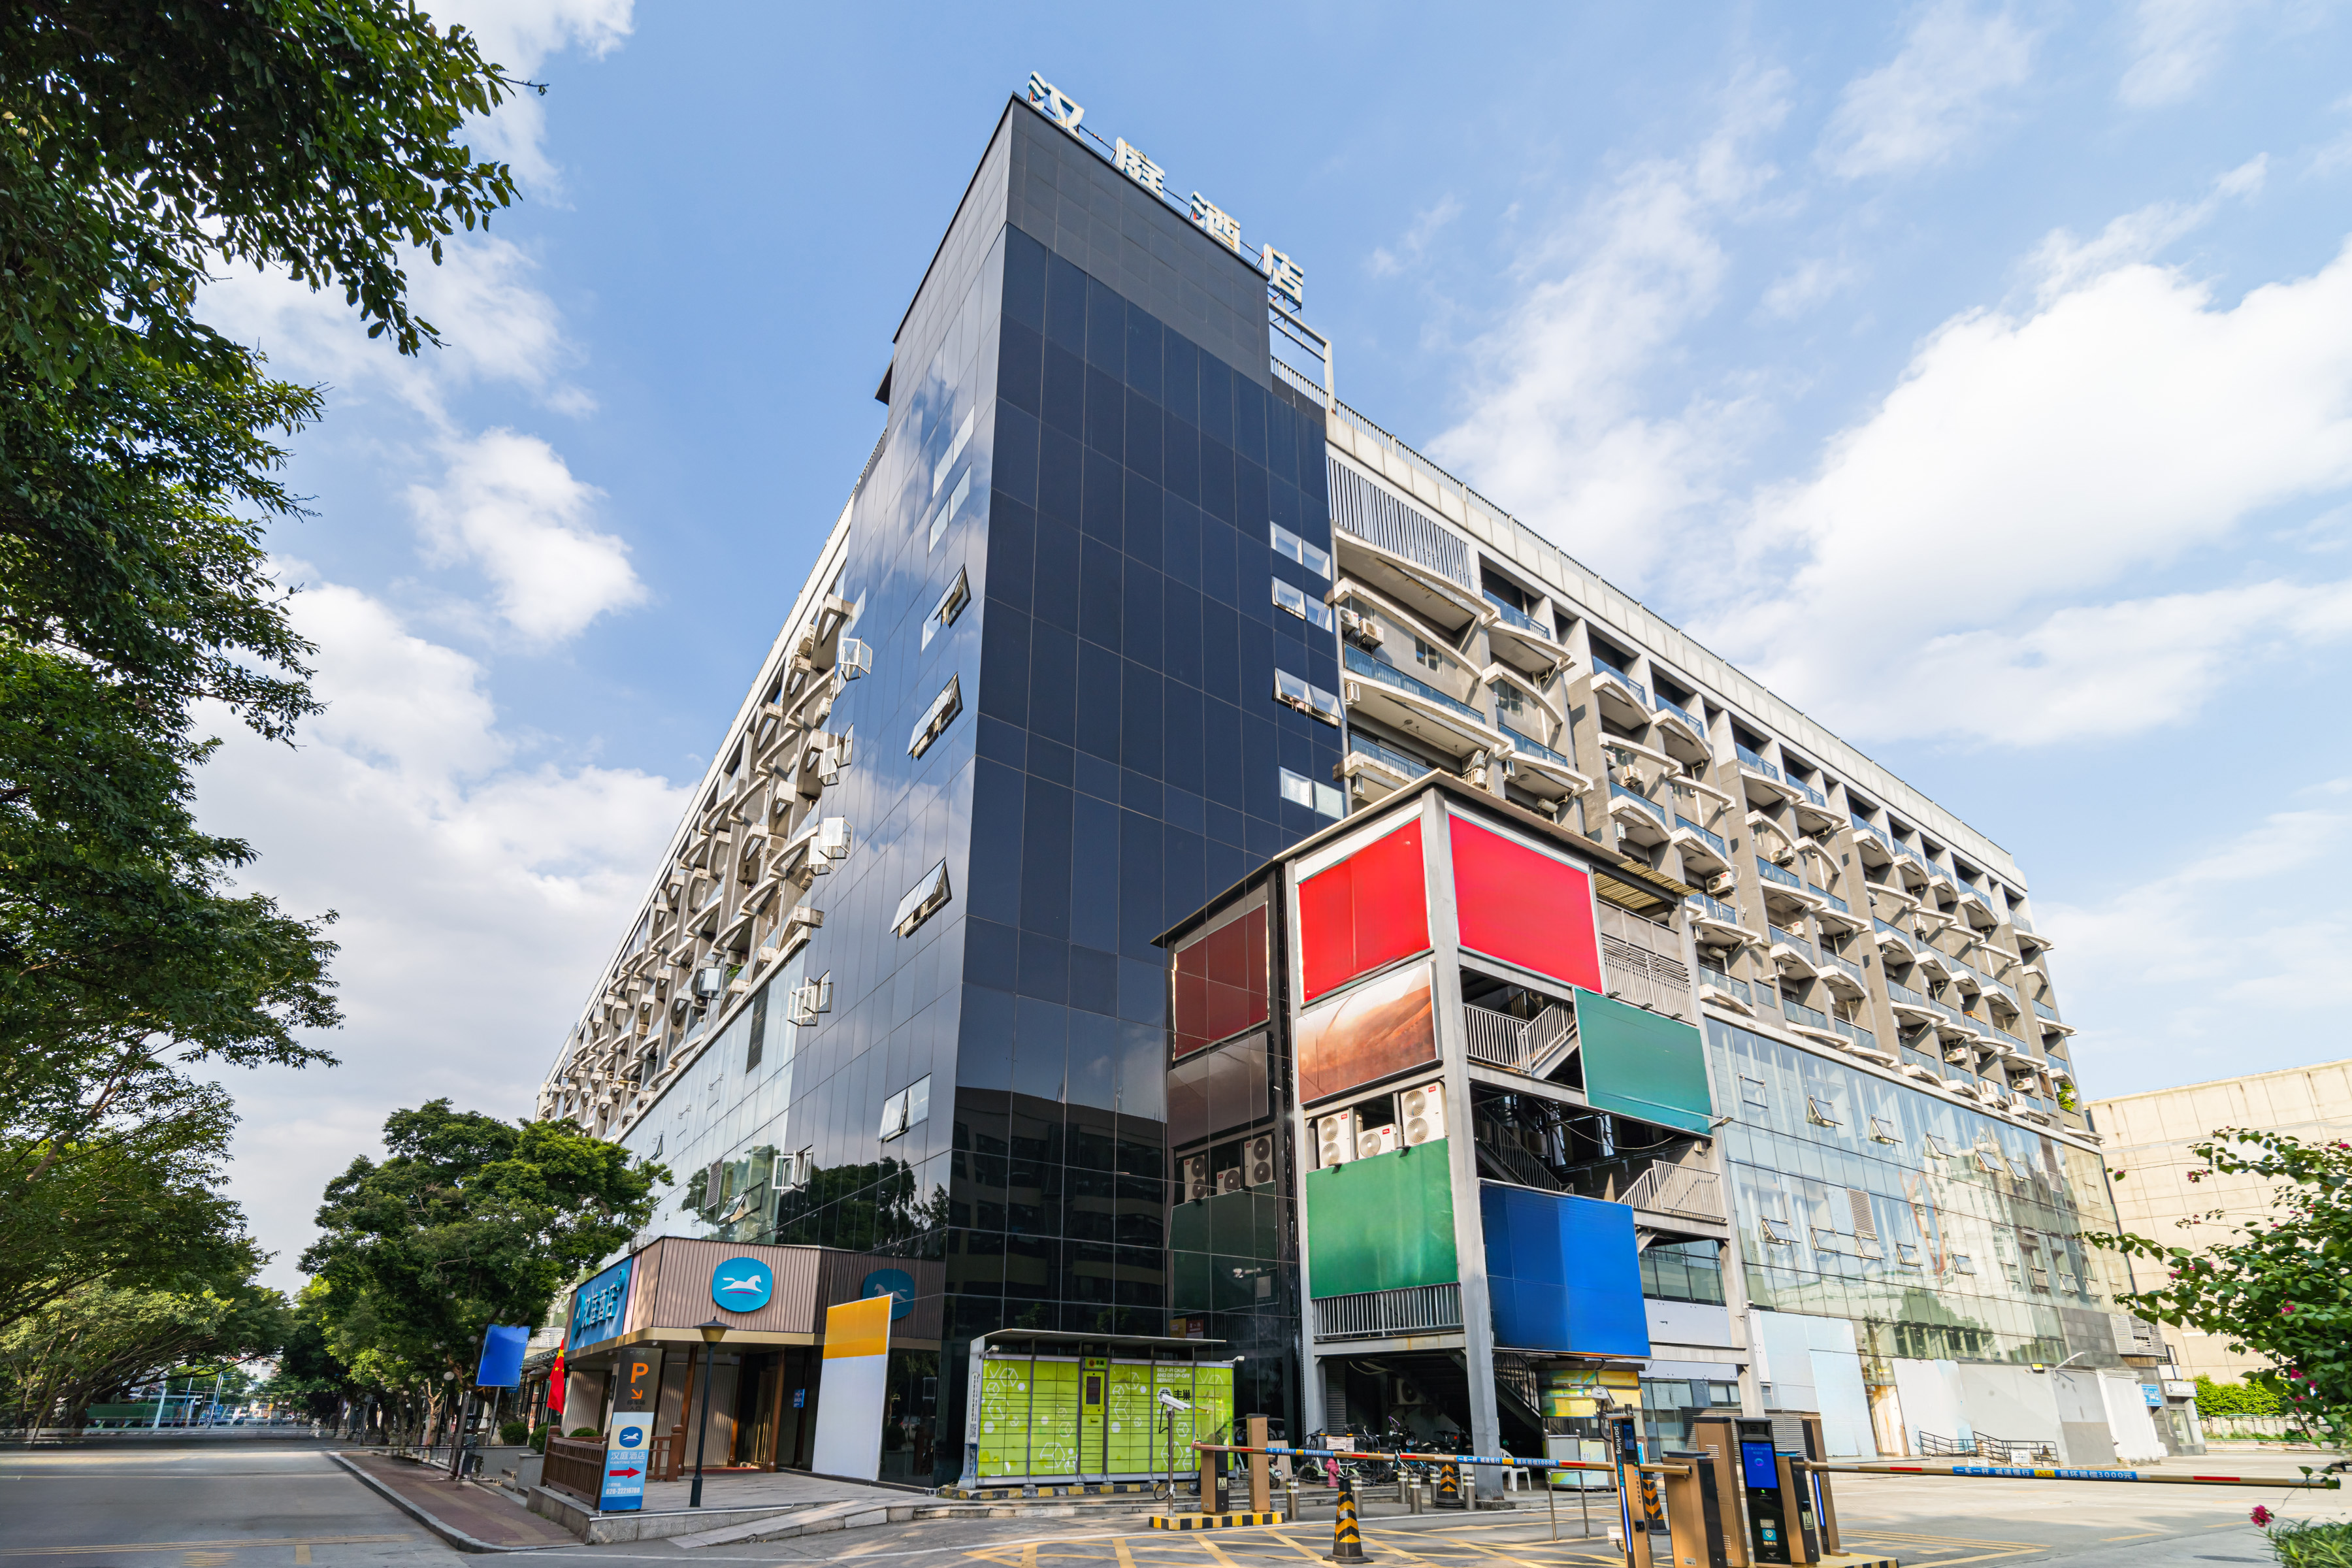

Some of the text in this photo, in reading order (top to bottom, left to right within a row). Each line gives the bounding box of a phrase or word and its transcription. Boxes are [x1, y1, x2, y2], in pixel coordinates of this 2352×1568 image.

[1028, 71, 1303, 307] 汉庭酒店
[581, 1282, 617, 1328] 汉庭酒店
[630, 1363, 649, 1383] P
[1174, 1389, 1190, 1400] 丰巢
[2060, 1471, 2133, 1479] 损坏赔偿3000元
